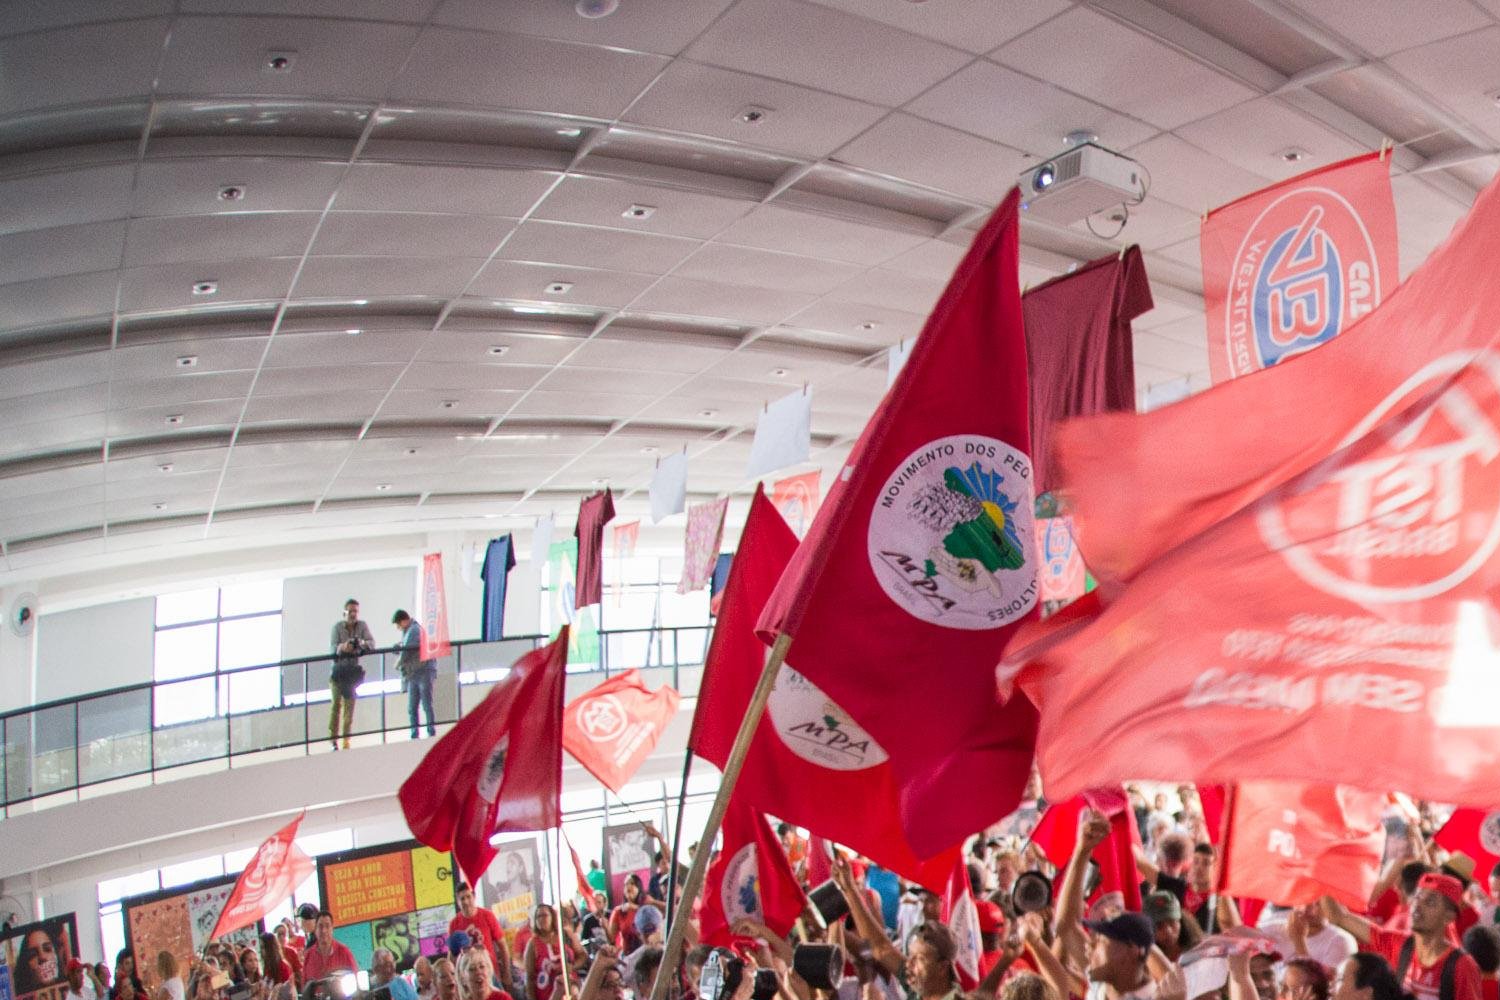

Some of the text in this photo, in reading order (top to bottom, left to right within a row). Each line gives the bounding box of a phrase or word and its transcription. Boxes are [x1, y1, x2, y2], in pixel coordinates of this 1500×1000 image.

[881, 443, 955, 509] MOVIMENTO
[964, 442, 997, 459] DOS
[1003, 453, 1031, 480] PEQ
[788, 721, 870, 754] MPA
